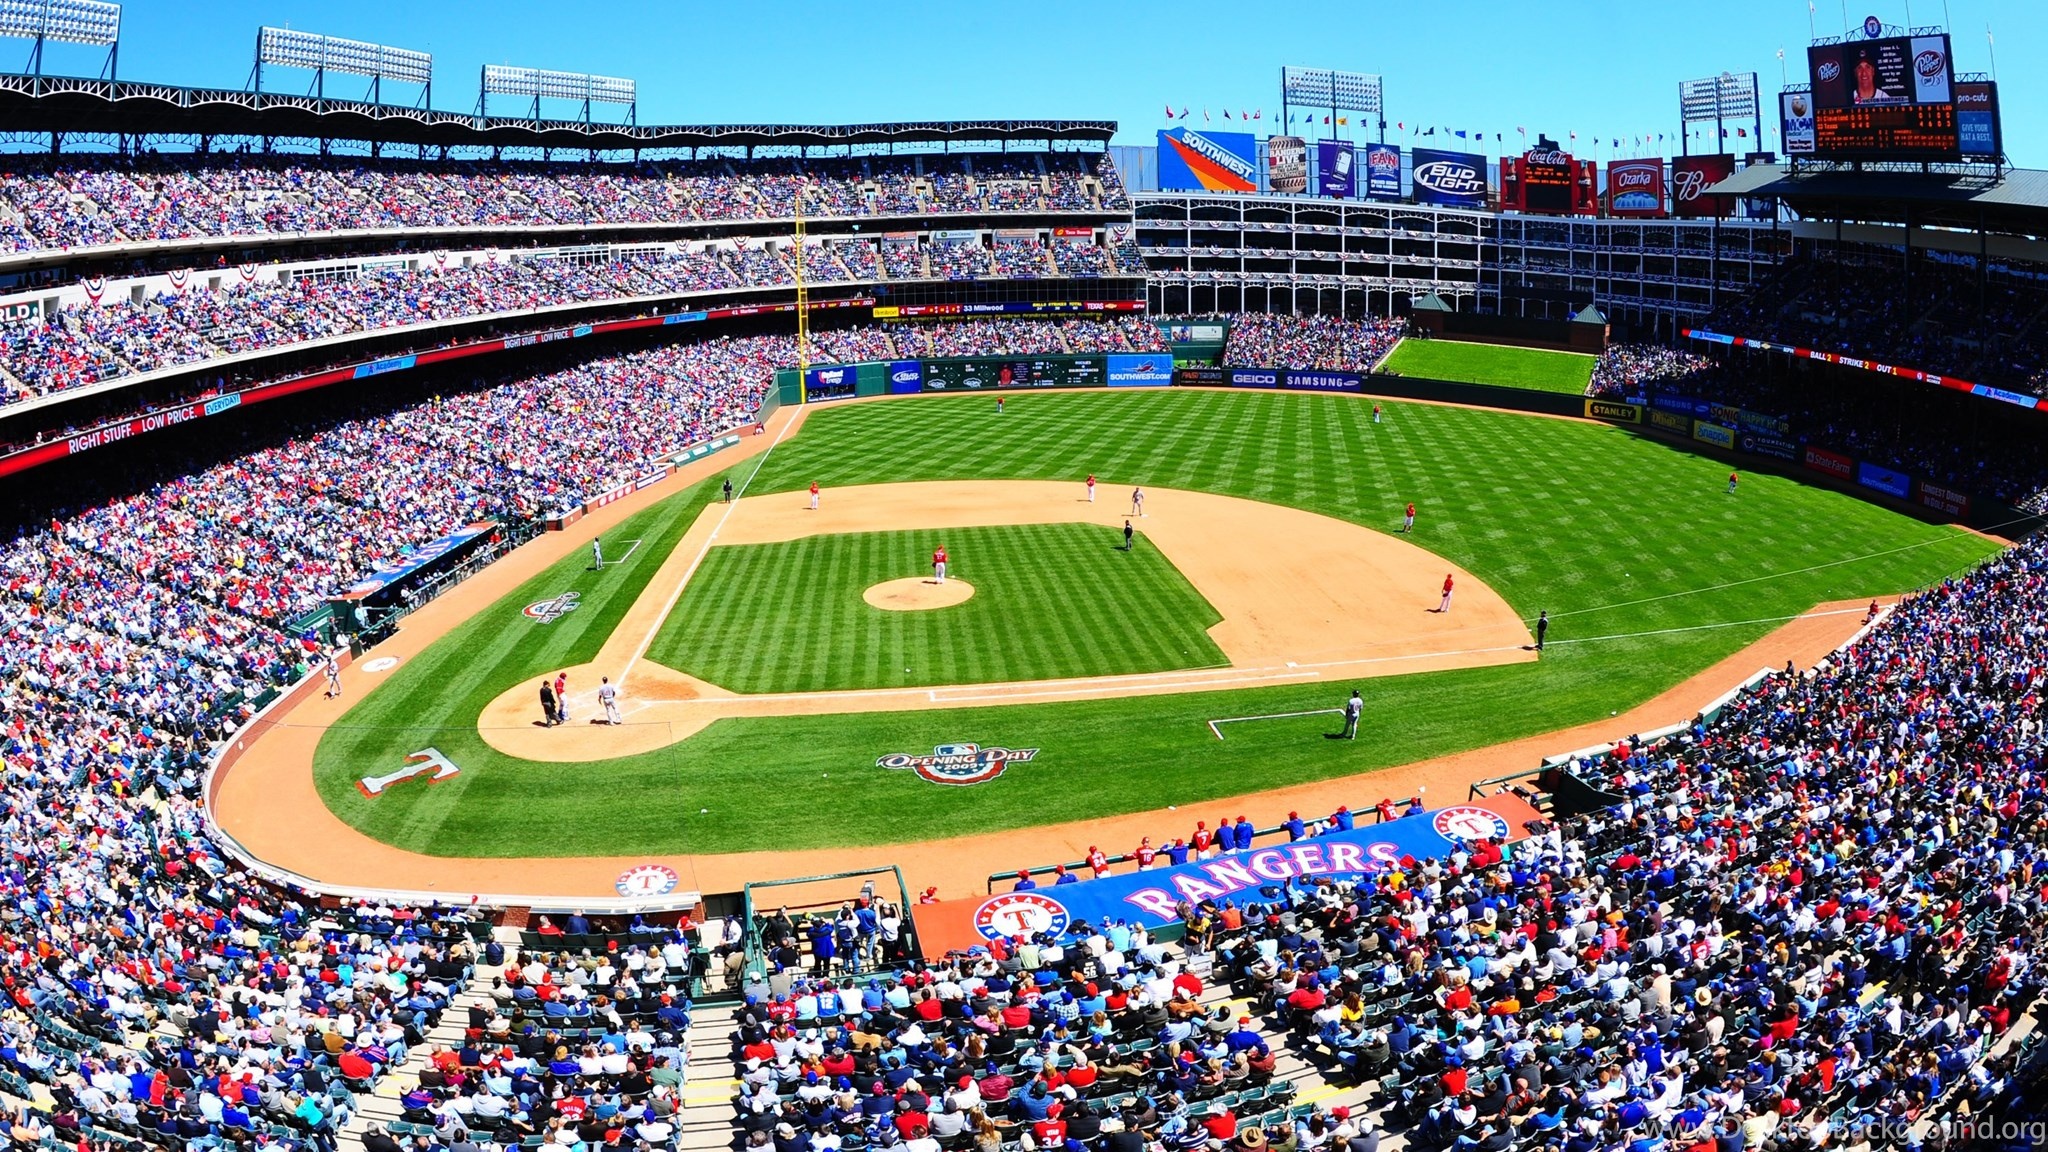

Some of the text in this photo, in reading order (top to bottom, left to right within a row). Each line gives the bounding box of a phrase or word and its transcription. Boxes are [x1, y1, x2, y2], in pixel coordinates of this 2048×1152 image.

[1957, 92, 1988, 104] pro-cuts
[1961, 123, 1988, 132] GIVE YOUR
[1961, 132, 1971, 141] HAT
[1180, 131, 1254, 179] SOUTHWEST
[1269, 147, 1306, 158] RANGERS
[1370, 153, 1397, 165] FAN
[1276, 154, 1299, 165] LIVE
[1430, 164, 1476, 180] BUD
[1421, 173, 1484, 192] LIGHT
[1619, 171, 1651, 187] Ozarka
[504, 337, 520, 350] RIGHT
[541, 333, 553, 343] LOW
[1811, 351, 1826, 361] BALL
[1839, 356, 1863, 369] STRIKE
[1877, 364, 1892, 375] OUT
[1233, 374, 1276, 384] GEICO
[1287, 375, 1343, 387] SAMSUNG
[1994, 389, 2023, 403] Academy
[205, 393, 241, 416] EVERYDAY!
[1654, 397, 1692, 410] SAMSUNG
[1593, 404, 1633, 418] STANLEY
[68, 406, 197, 455] RIGHT STUFF. LOW PRICE.
[1767, 419, 1790, 433] HUR
[1698, 424, 1731, 443] Snapple
[885, 748, 1033, 768] OPENING DAY
[354, 746, 462, 800] T
[944, 763, 978, 771] 2009
[1455, 817, 1487, 835] T
[1201, 835, 1207, 845] 7
[1093, 858, 1106, 868] 24
[1143, 853, 1152, 862] 16
[636, 875, 658, 889] T
[1124, 841, 1404, 922] RANGERS
[983, 896, 1048, 916] TEXAS
[1003, 908, 1037, 932] T
[1683, 953, 1691, 963] 5
[1083, 966, 1097, 978] 56
[820, 997, 835, 1010] 12
[1042, 1135, 1063, 1147] 34
